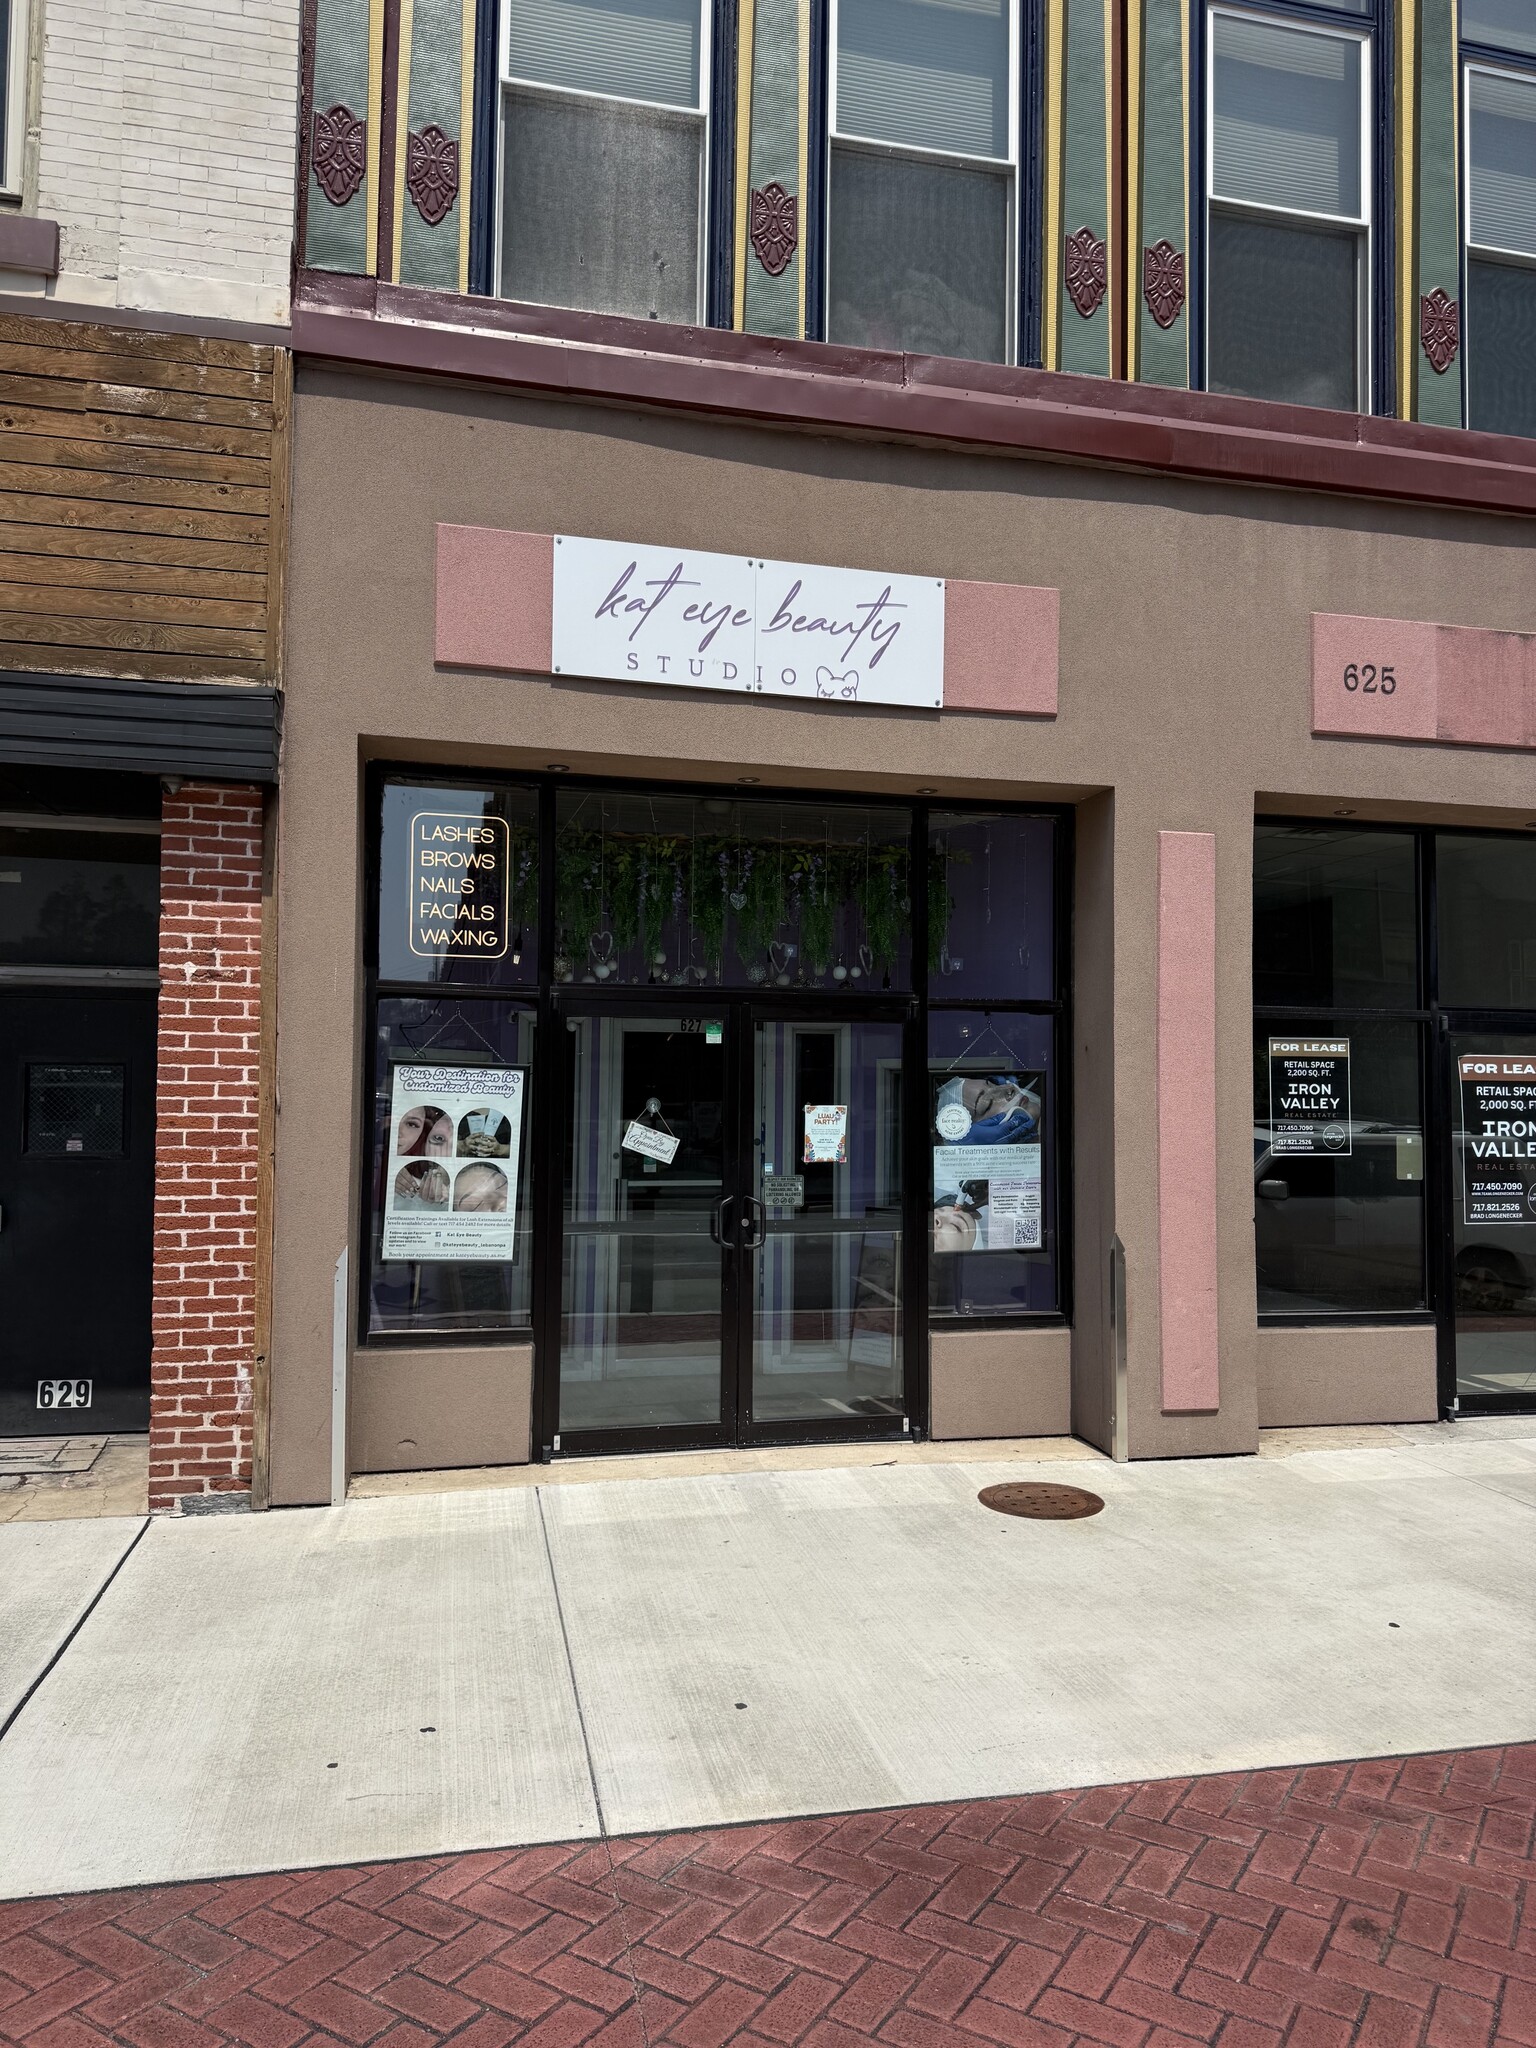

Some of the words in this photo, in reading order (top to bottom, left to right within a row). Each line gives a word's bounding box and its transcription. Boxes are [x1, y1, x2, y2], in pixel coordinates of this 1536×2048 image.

[595, 561, 701, 641] kat
[683, 601, 752, 652] eye
[761, 580, 907, 669] beauty
[627, 653, 797, 686] STUDIO
[1344, 664, 1396, 695] 625
[421, 825, 494, 844] LASHES
[421, 850, 495, 869] BROWS
[421, 877, 475, 894] NAILS
[420, 903, 495, 921] FACIALS
[420, 928, 498, 946] WAXING
[681, 1018, 702, 1032] 627
[1273, 1043, 1300, 1052] FOR
[1304, 1044, 1346, 1052] LEASE
[399, 1066, 432, 1081] Your
[433, 1067, 500, 1082] Destination
[502, 1070, 520, 1083] for
[1462, 1063, 1498, 1074] FOR
[403, 1079, 470, 1093] Customized
[470, 1081, 515, 1098] Beauty
[1288, 1083, 1331, 1095] IRON
[1476, 1086, 1512, 1096] RETAIL
[1280, 1098, 1340, 1110] VALLEY
[1480, 1100, 1508, 1111] 2,000
[1510, 1100, 1527, 1111] SQ.
[1482, 1120, 1536, 1137] IRON
[629, 1134, 671, 1155] Appointment
[1471, 1141, 1536, 1158] VALLE
[1472, 1183, 1523, 1191] 717.450.7090
[1472, 1203, 1520, 1211] 717.821.2526
[40, 1381, 90, 1407] 629
